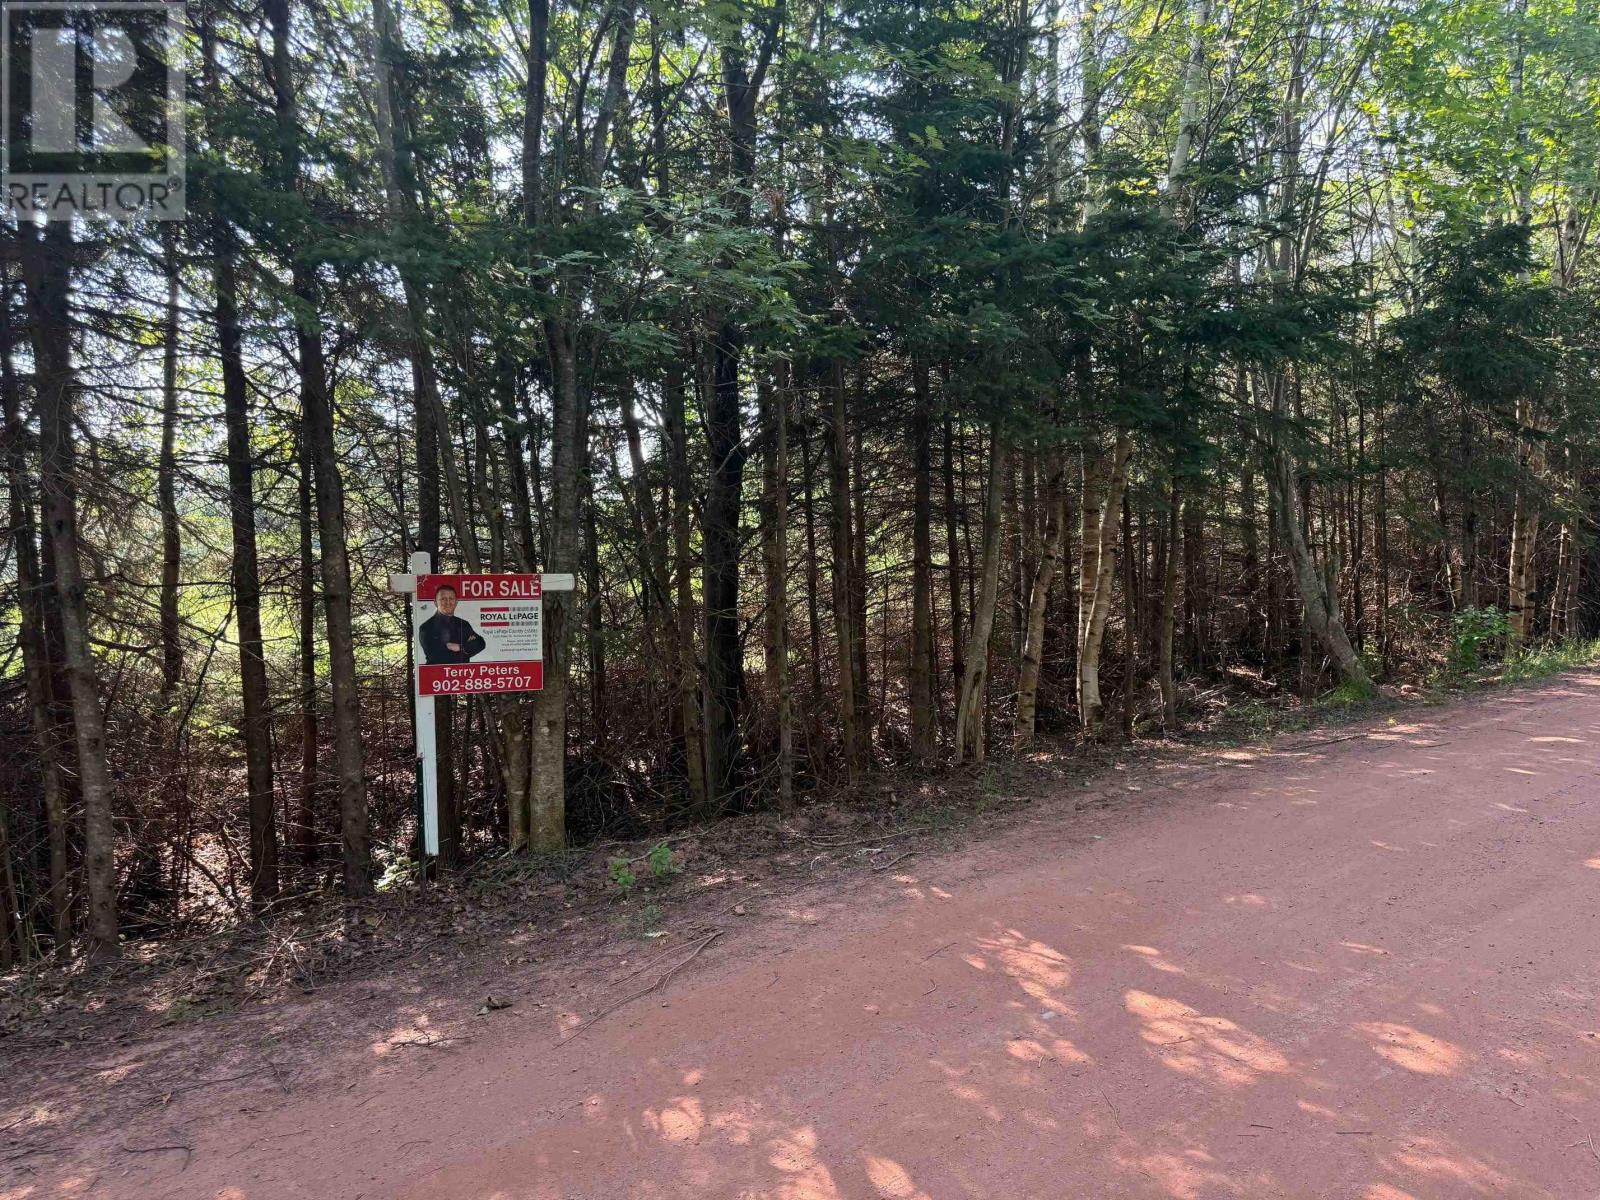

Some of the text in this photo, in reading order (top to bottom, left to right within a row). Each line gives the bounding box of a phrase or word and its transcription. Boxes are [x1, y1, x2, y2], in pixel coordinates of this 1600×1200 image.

[461, 579, 540, 597] FOR SALE
[444, 666, 519, 678] Terry Peters
[432, 676, 532, 692] 902-888-5707
